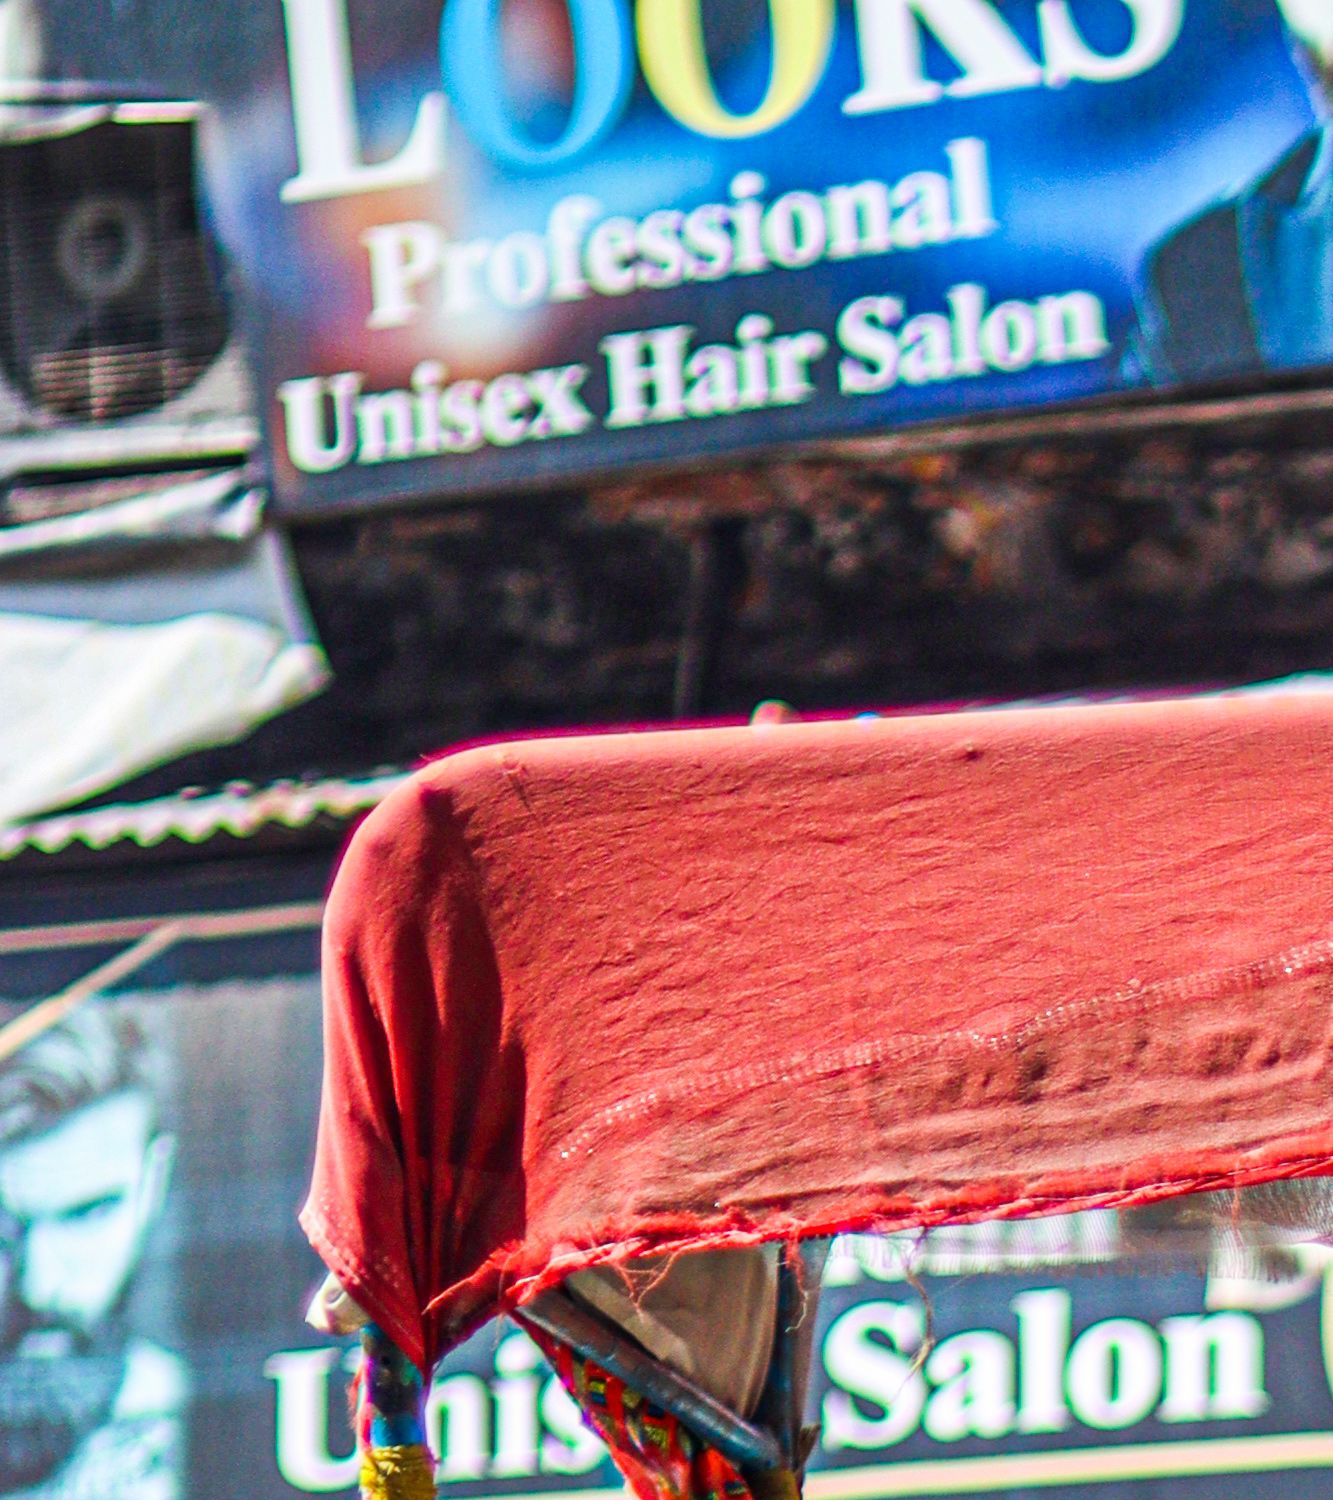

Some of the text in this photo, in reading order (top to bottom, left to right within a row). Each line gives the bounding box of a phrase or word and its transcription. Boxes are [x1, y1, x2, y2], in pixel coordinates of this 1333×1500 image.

[365, 137, 996, 328] Professional
[279, 283, 1110, 474] Unisex Hair Salon
[822, 1287, 1270, 1451] Salon
